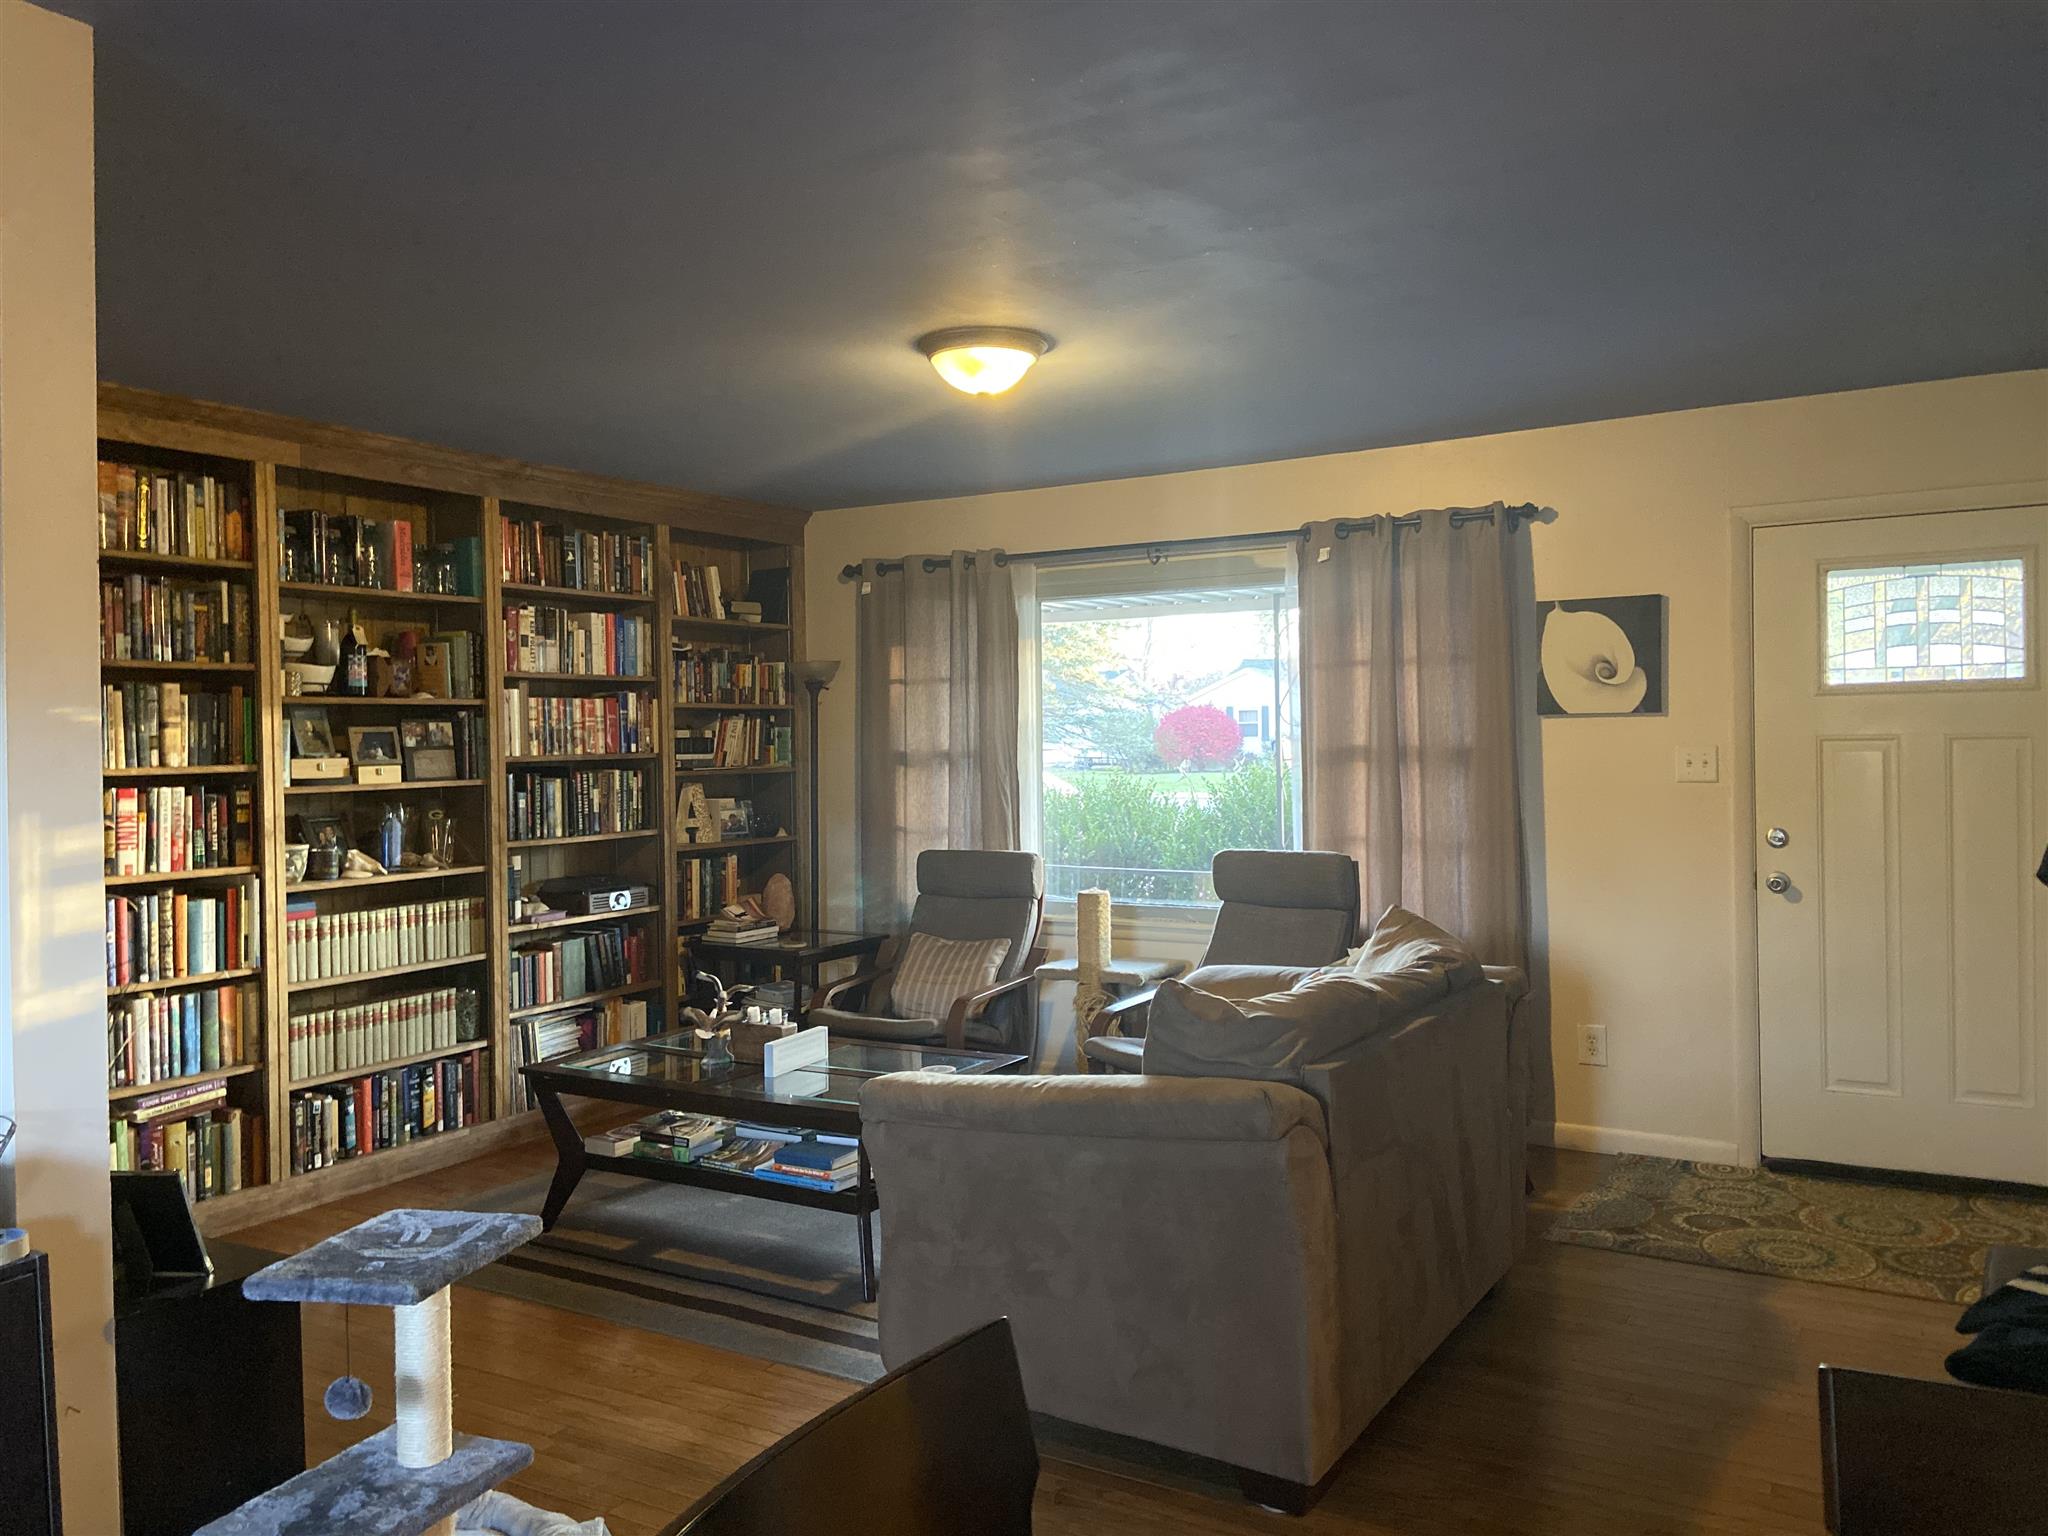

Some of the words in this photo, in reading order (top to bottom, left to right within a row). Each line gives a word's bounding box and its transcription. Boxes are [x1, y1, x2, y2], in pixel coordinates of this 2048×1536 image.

[676, 782, 713, 844] A
[116, 816, 139, 851] KING
[160, 1093, 177, 1103] ONCE
[186, 1088, 198, 1097] ALL
[197, 1083, 214, 1093] WEEK
